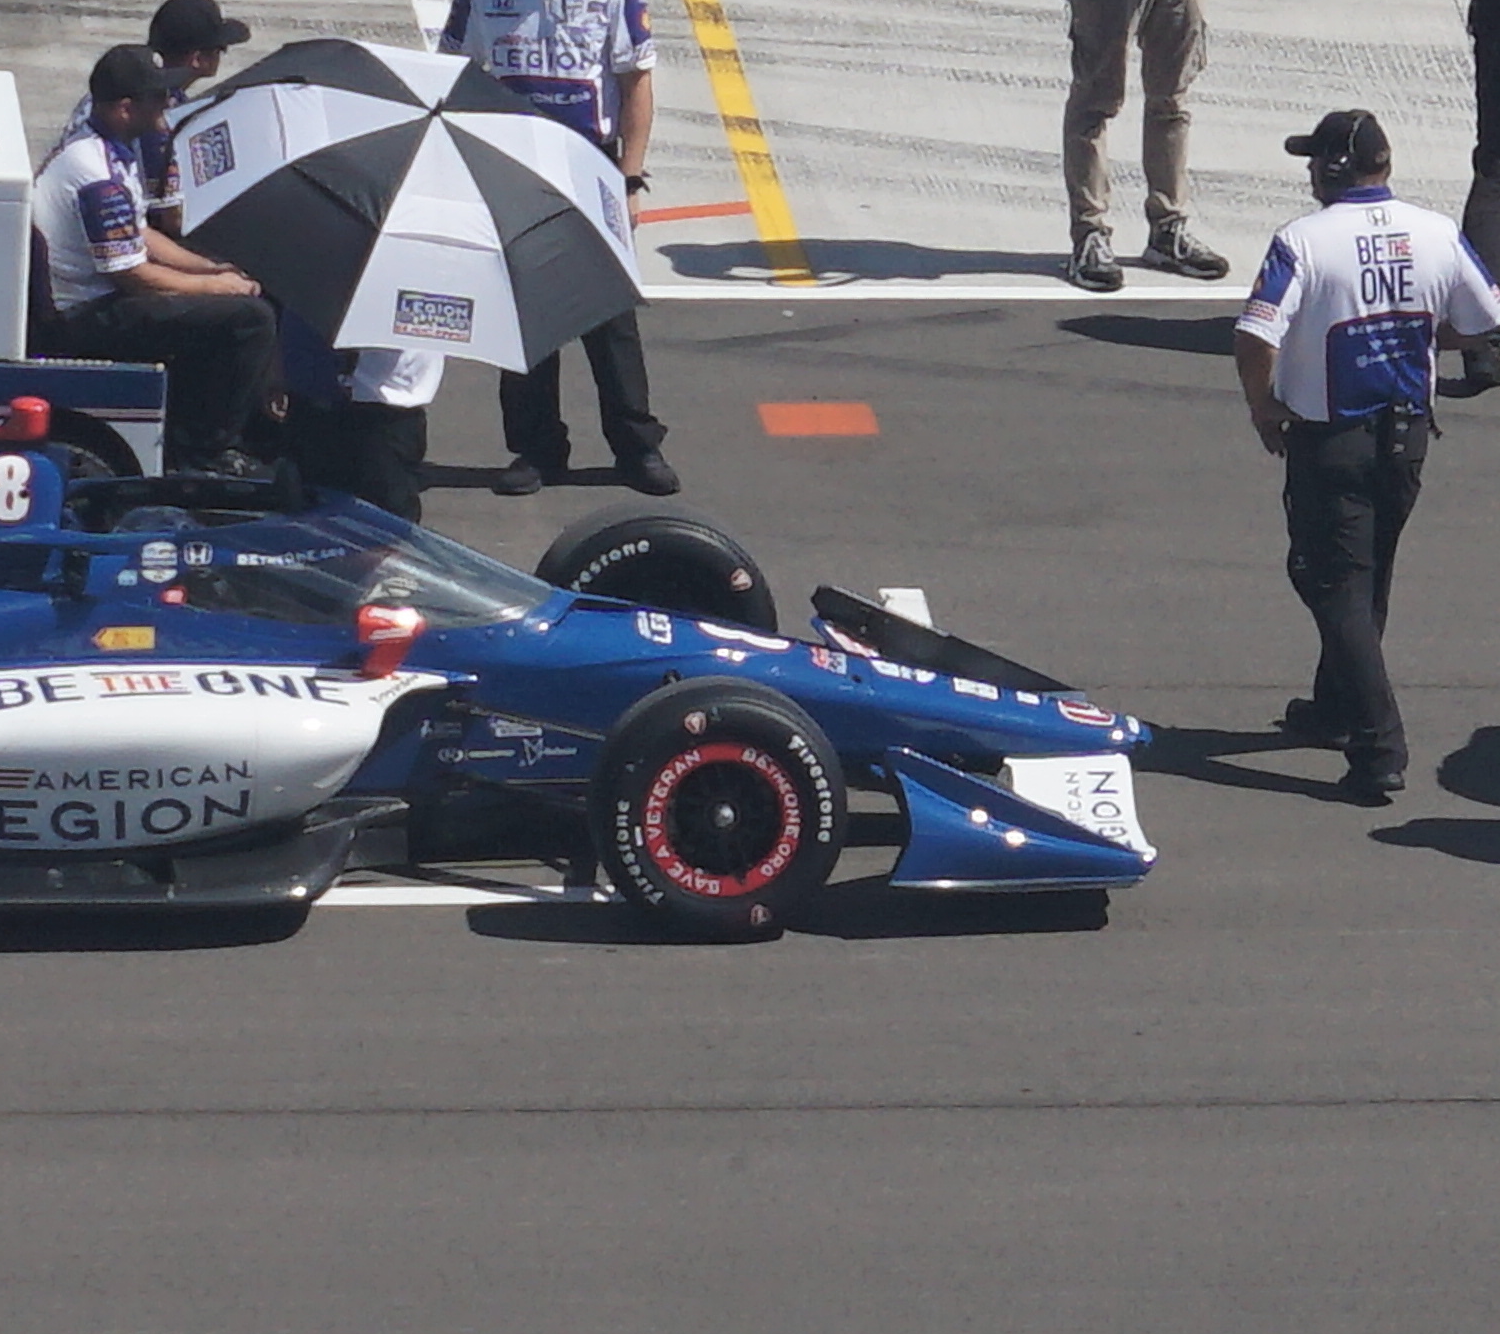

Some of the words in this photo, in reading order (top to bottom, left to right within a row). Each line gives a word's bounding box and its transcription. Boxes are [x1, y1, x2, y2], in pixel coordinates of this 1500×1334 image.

[1357, 234, 1384, 266] BE
[1386, 239, 1412, 257] THE
[1361, 268, 1414, 305] ONE
[101, 674, 183, 696] THE
[200, 671, 351, 707] ONE
[33, 761, 251, 793] AMERICAN
[645, 747, 702, 838] VETERAN
[790, 734, 833, 846] Firestone
[615, 799, 665, 907] Firestone
